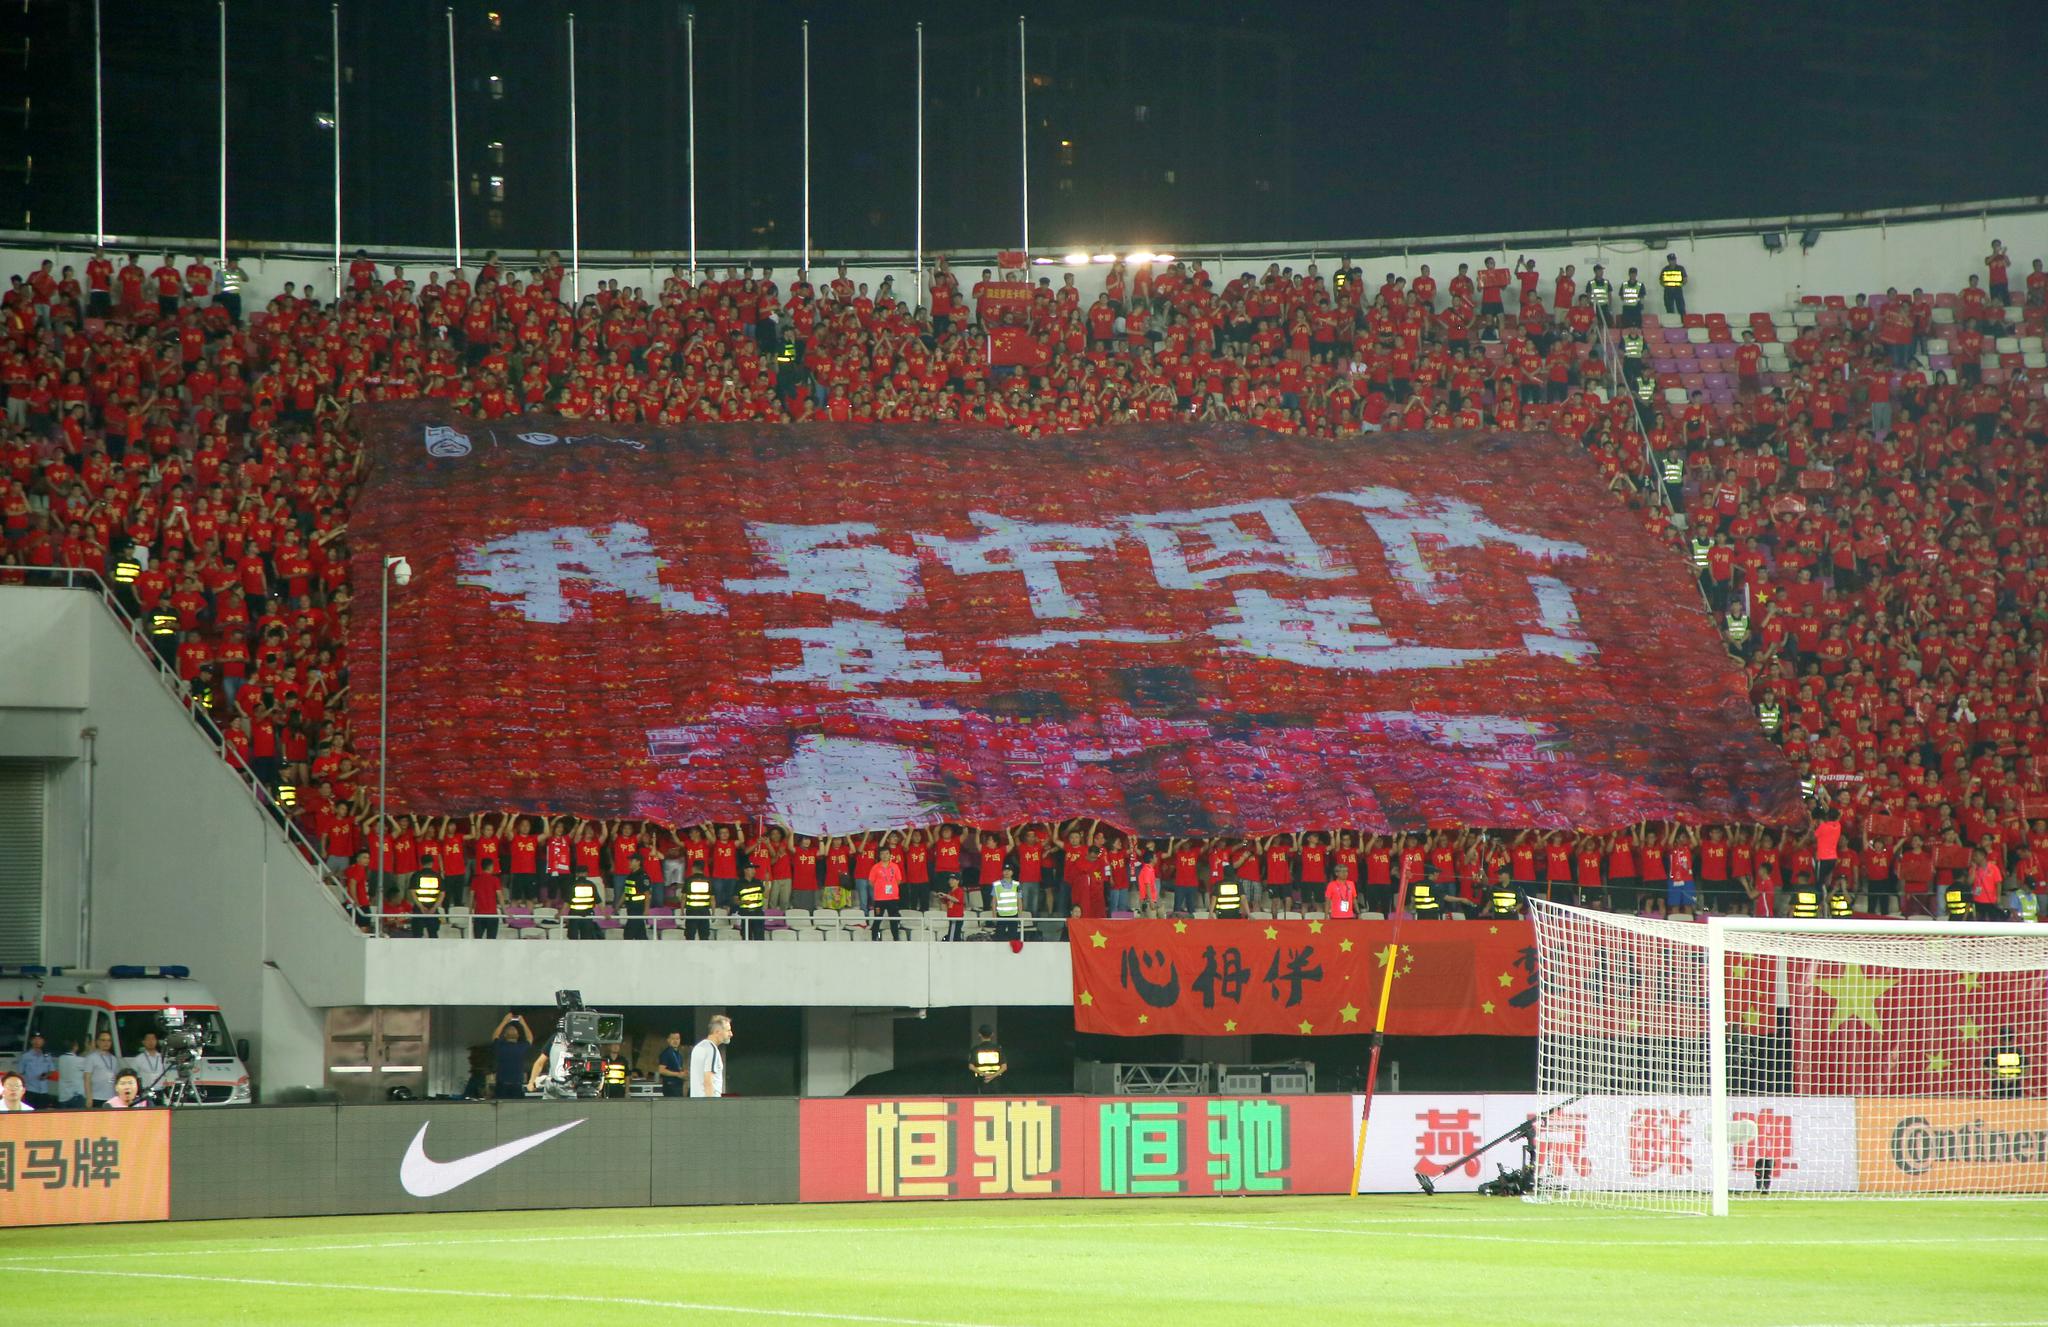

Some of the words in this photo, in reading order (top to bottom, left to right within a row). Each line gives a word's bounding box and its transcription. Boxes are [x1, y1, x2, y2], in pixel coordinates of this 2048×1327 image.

[1121, 945, 1324, 1008] 心相伴
[866, 1102, 1053, 1197] 恒驰
[1100, 1100, 1284, 1195] 恒驰
